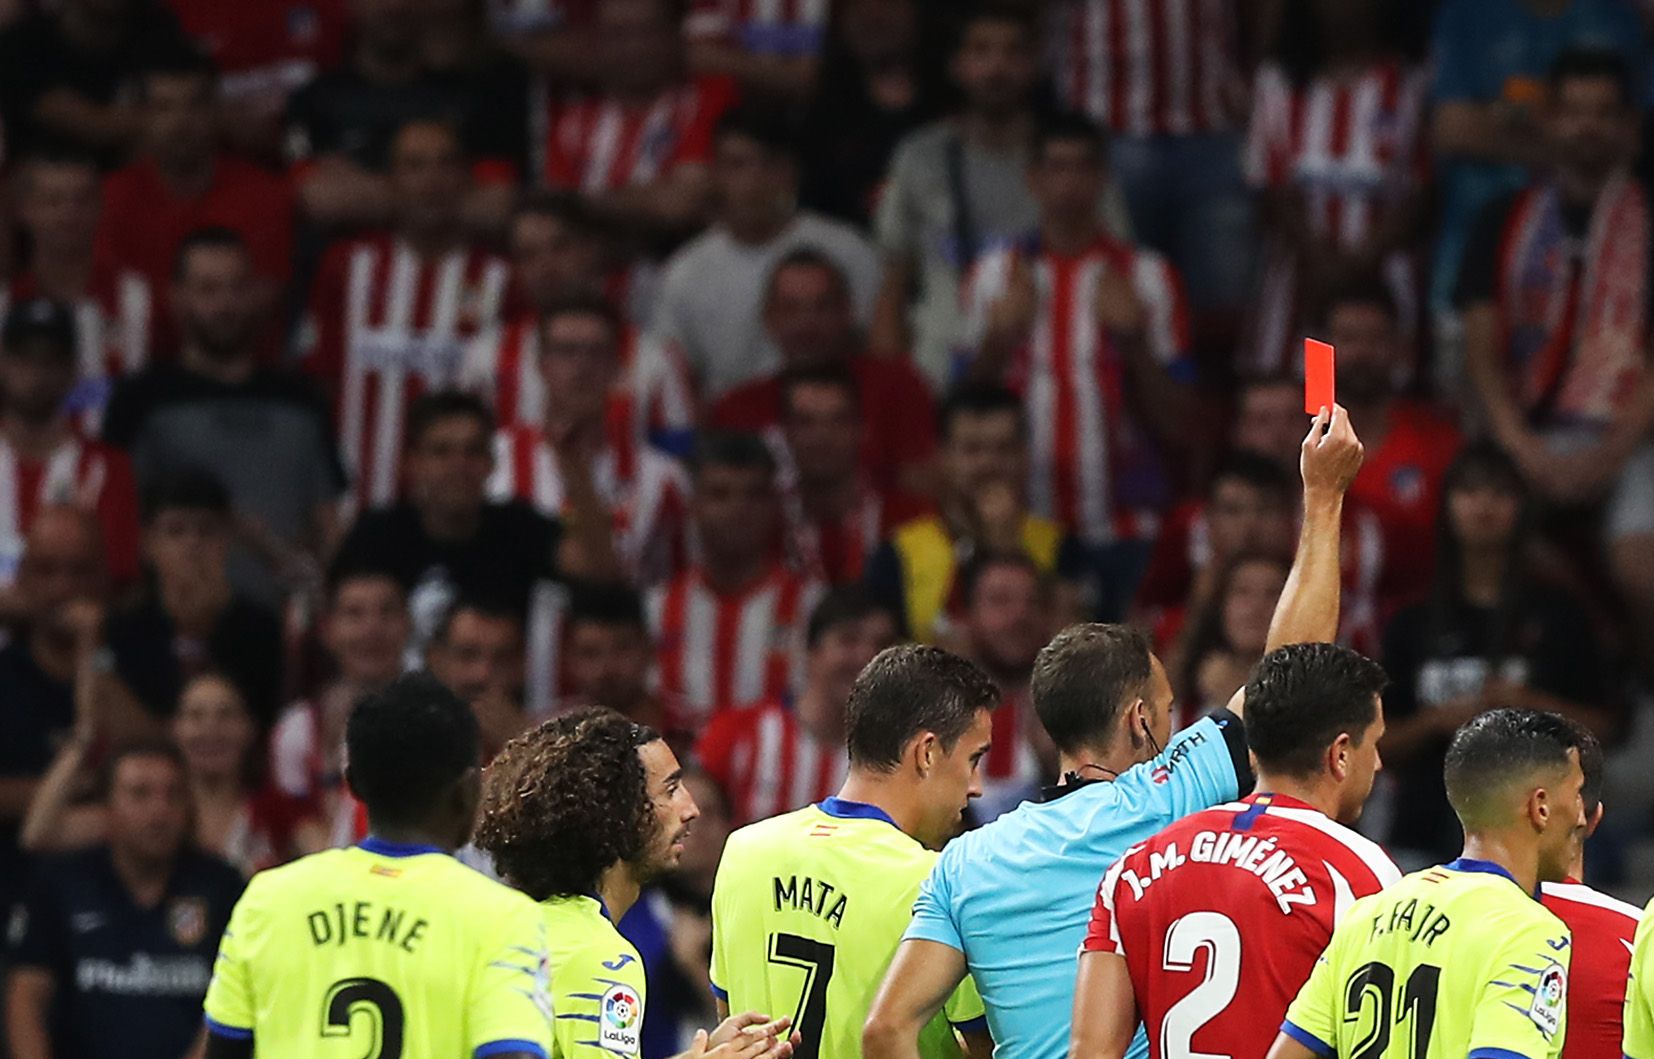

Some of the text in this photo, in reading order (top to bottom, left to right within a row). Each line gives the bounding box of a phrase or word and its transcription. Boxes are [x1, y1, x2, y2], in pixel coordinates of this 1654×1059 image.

[1190, 831, 1317, 915] GIMÉNEZ
[308, 902, 429, 953] DJENE
[773, 875, 848, 930] MATA
[604, 1030, 635, 1044] LaLiga
